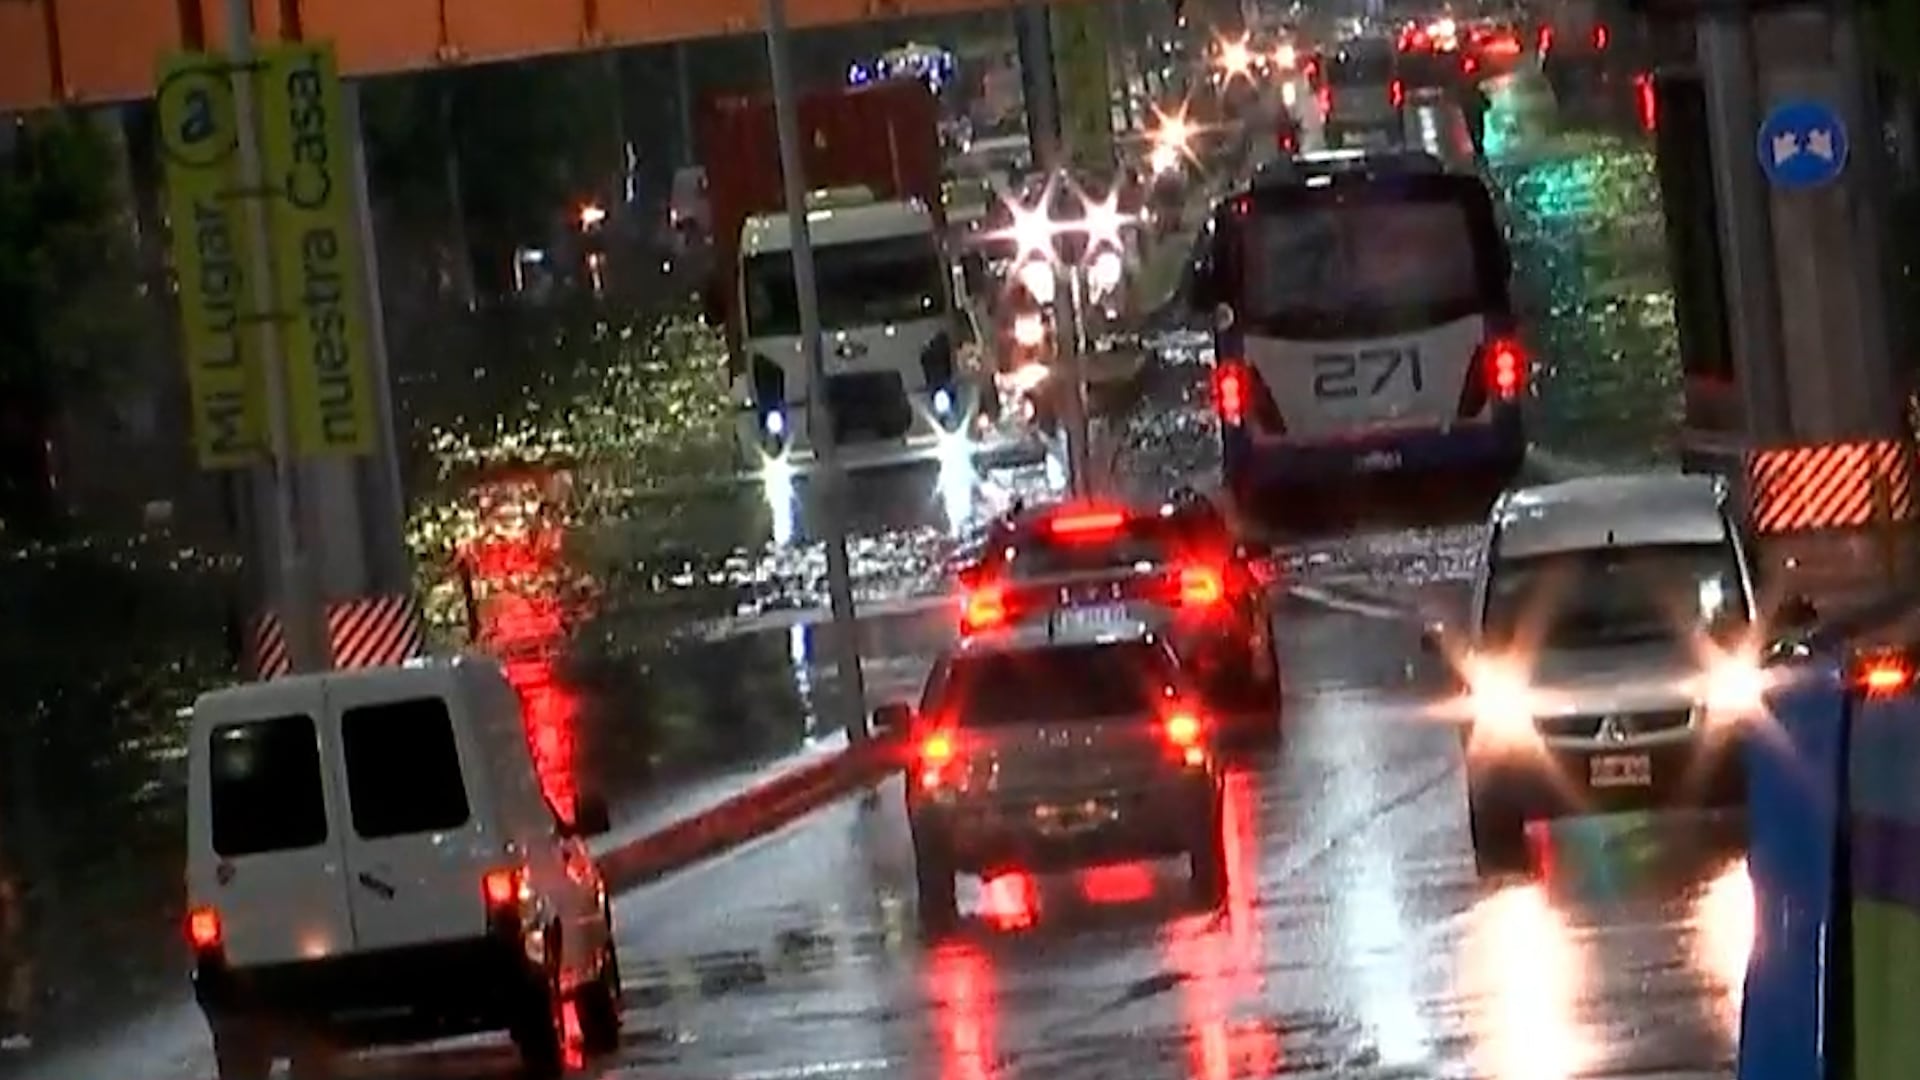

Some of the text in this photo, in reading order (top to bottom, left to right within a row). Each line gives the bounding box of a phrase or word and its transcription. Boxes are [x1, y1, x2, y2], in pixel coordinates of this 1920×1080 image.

[303, 227, 357, 445] nuestra
[1314, 344, 1422, 397] 271
[207, 393, 244, 453] Mi
